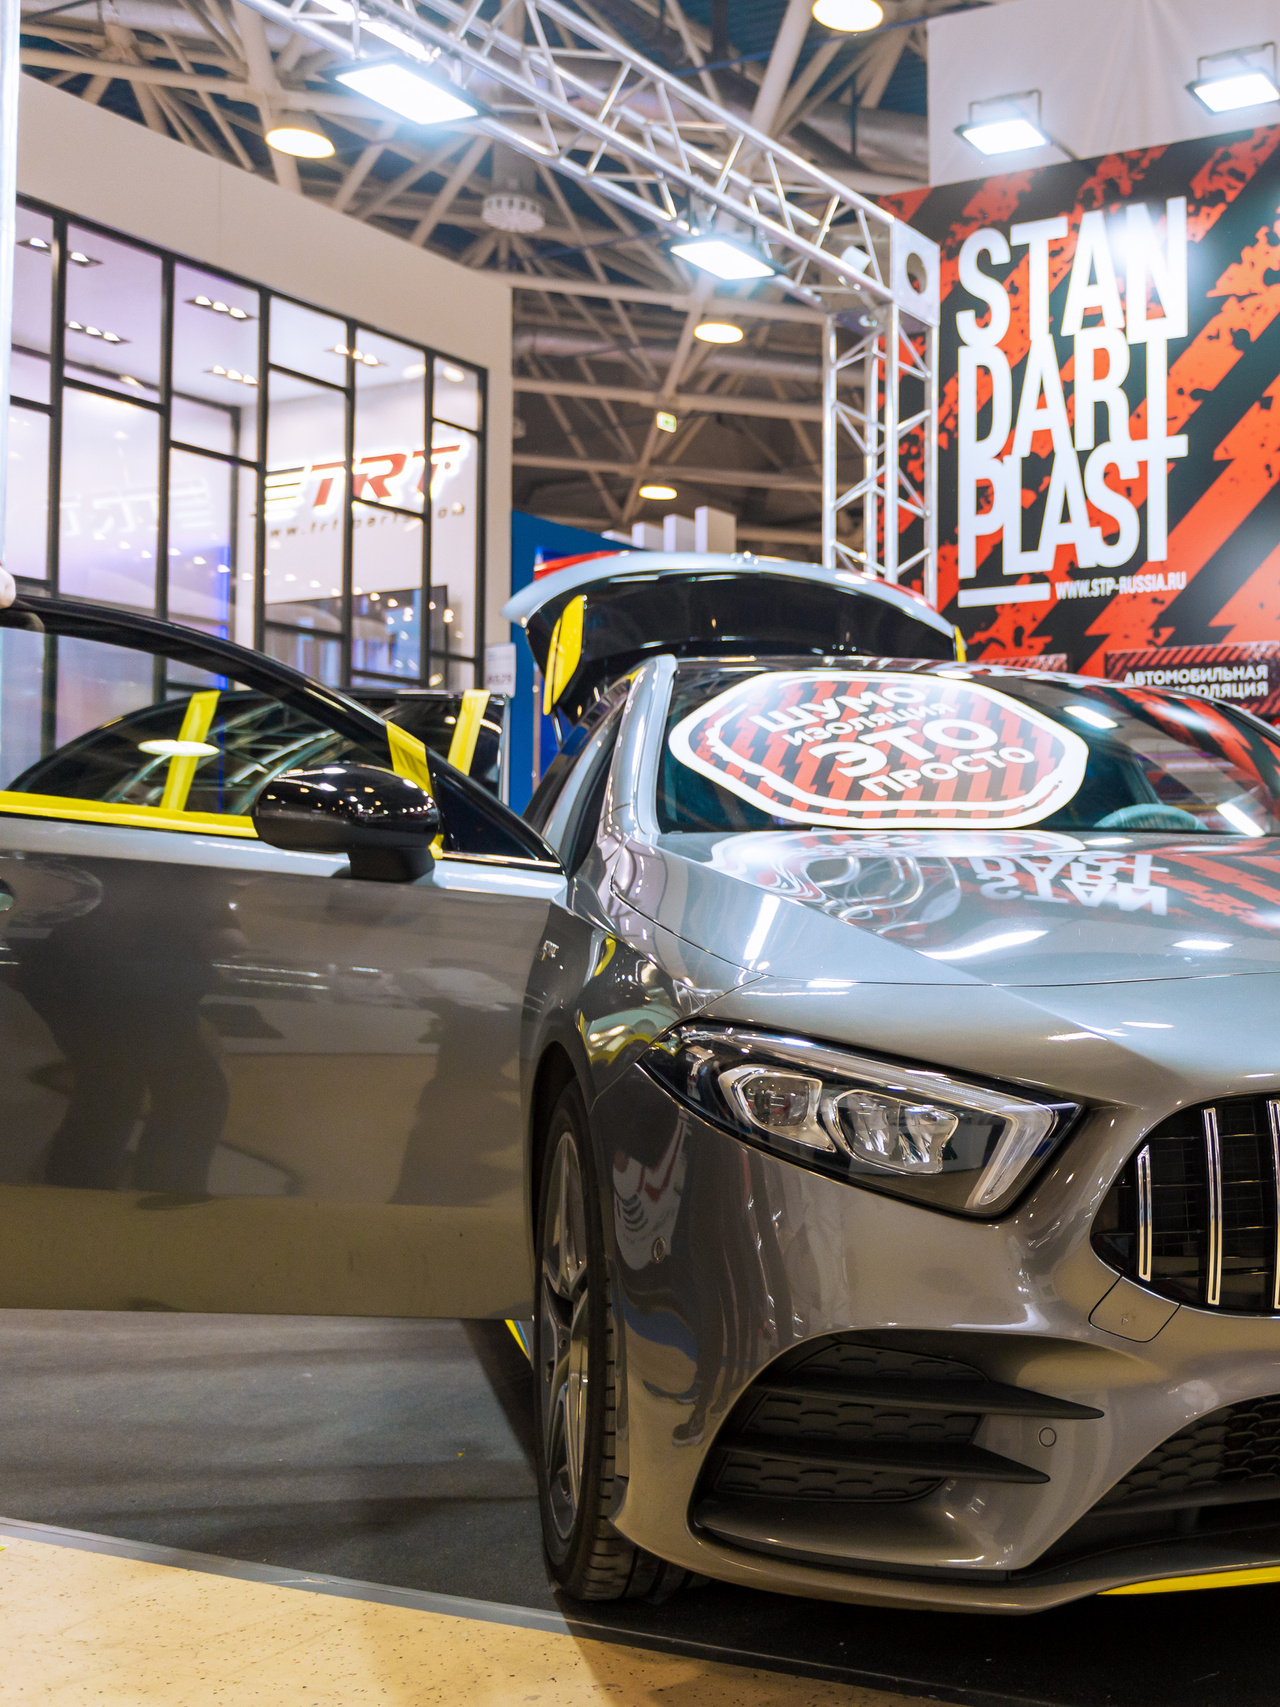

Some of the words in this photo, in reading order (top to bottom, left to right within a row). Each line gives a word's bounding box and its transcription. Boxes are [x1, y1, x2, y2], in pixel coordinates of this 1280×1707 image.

[955, 196, 1188, 347] STAN
[958, 322, 1188, 459] DART
[958, 435, 1188, 579] PLAST
[1055, 571, 1187, 600] WWW.STP-RUSSIA.RU
[1124, 664, 1269, 686] АВТОМОБИЛЬНАЯ
[749, 686, 926, 733] ШУМО
[781, 702, 957, 747] ИЗОЛЯЦИЯ
[808, 718, 999, 778] ЭТО
[858, 746, 1036, 796] ПРОСТО
